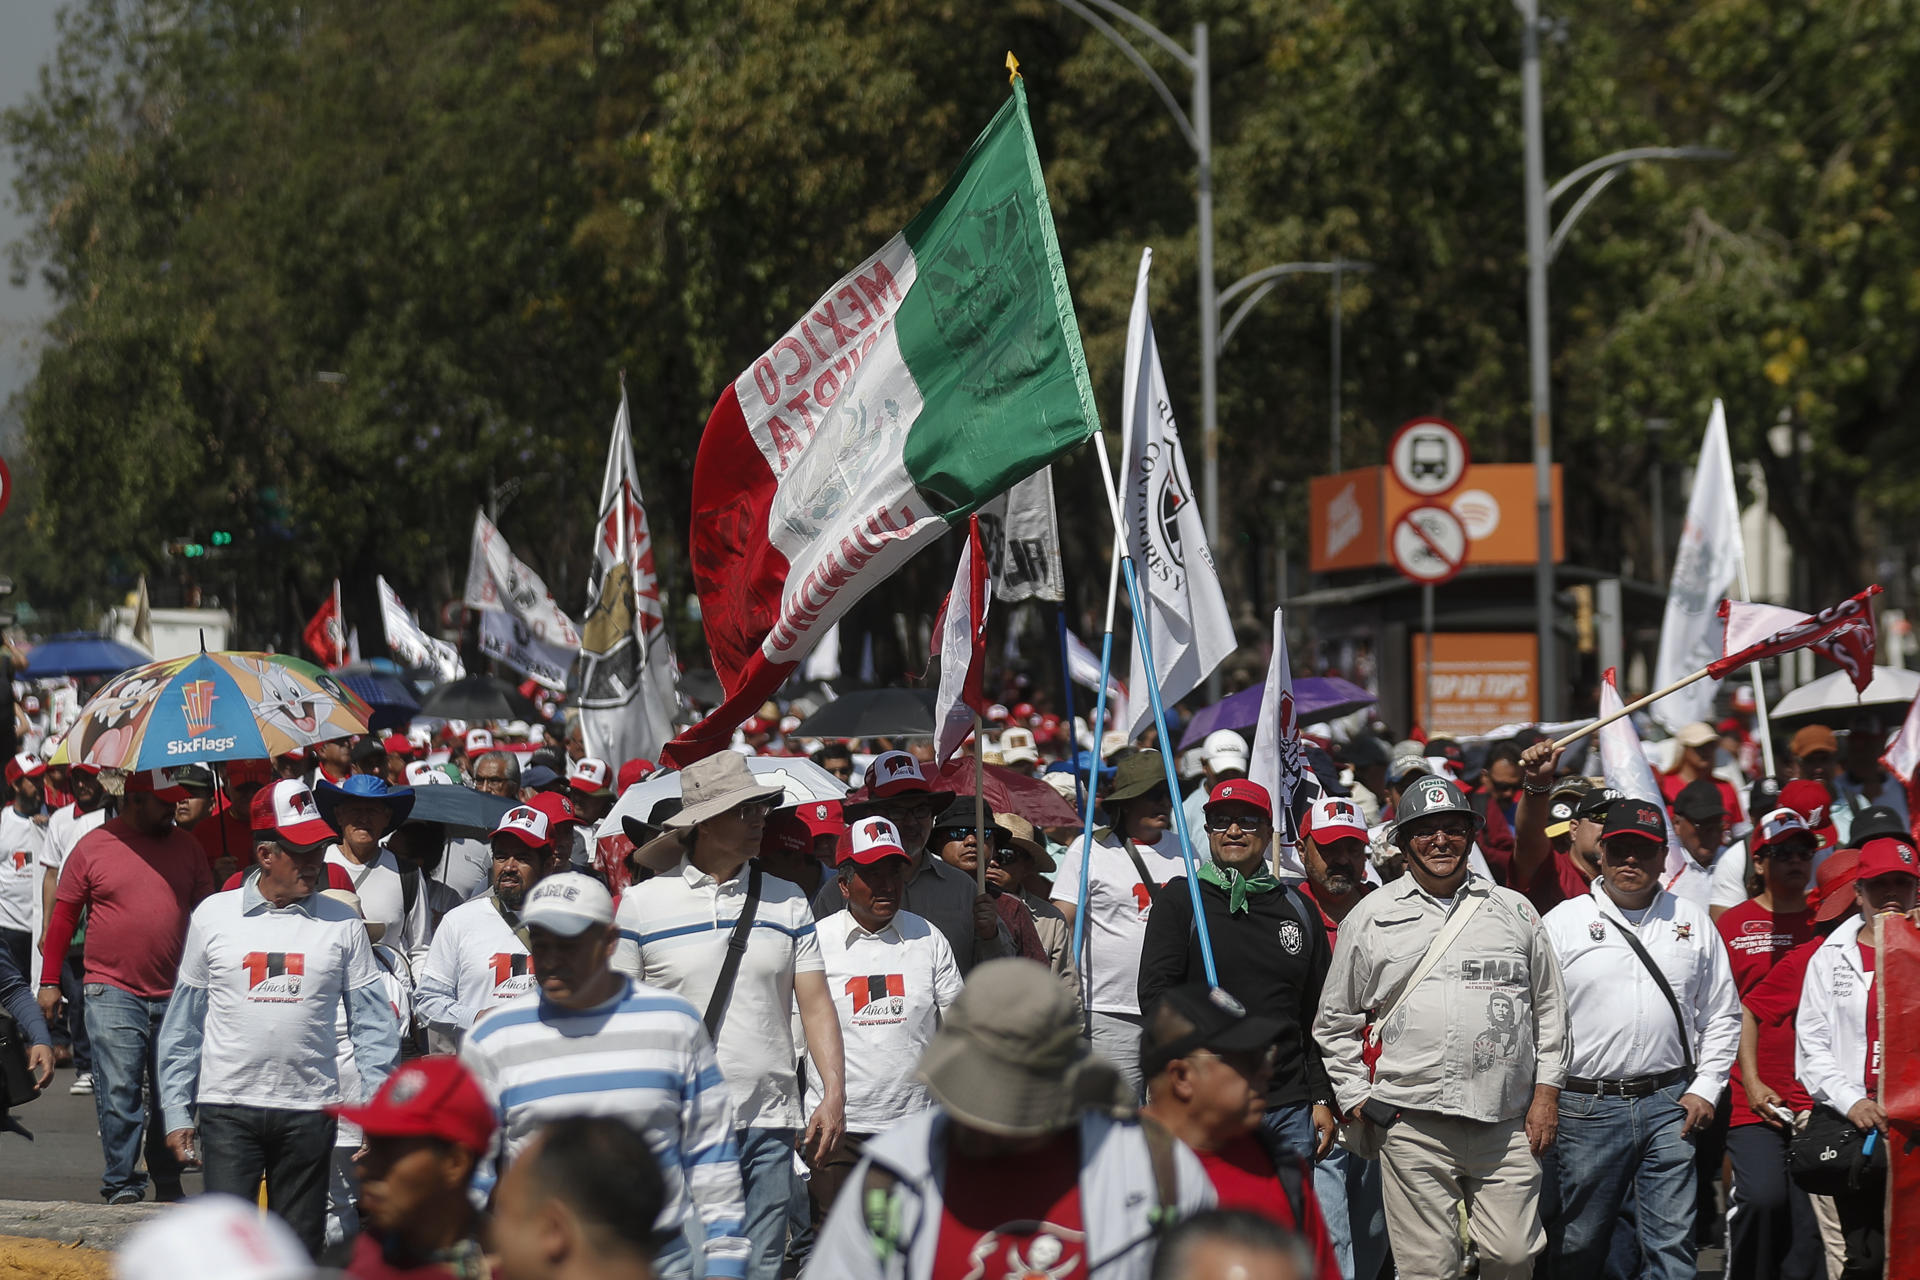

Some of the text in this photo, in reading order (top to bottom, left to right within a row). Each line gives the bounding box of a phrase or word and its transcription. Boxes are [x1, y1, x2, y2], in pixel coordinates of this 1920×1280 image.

[258, 981, 287, 992] Años
[503, 979, 526, 990] Años
[862, 1005, 889, 1015] Años
